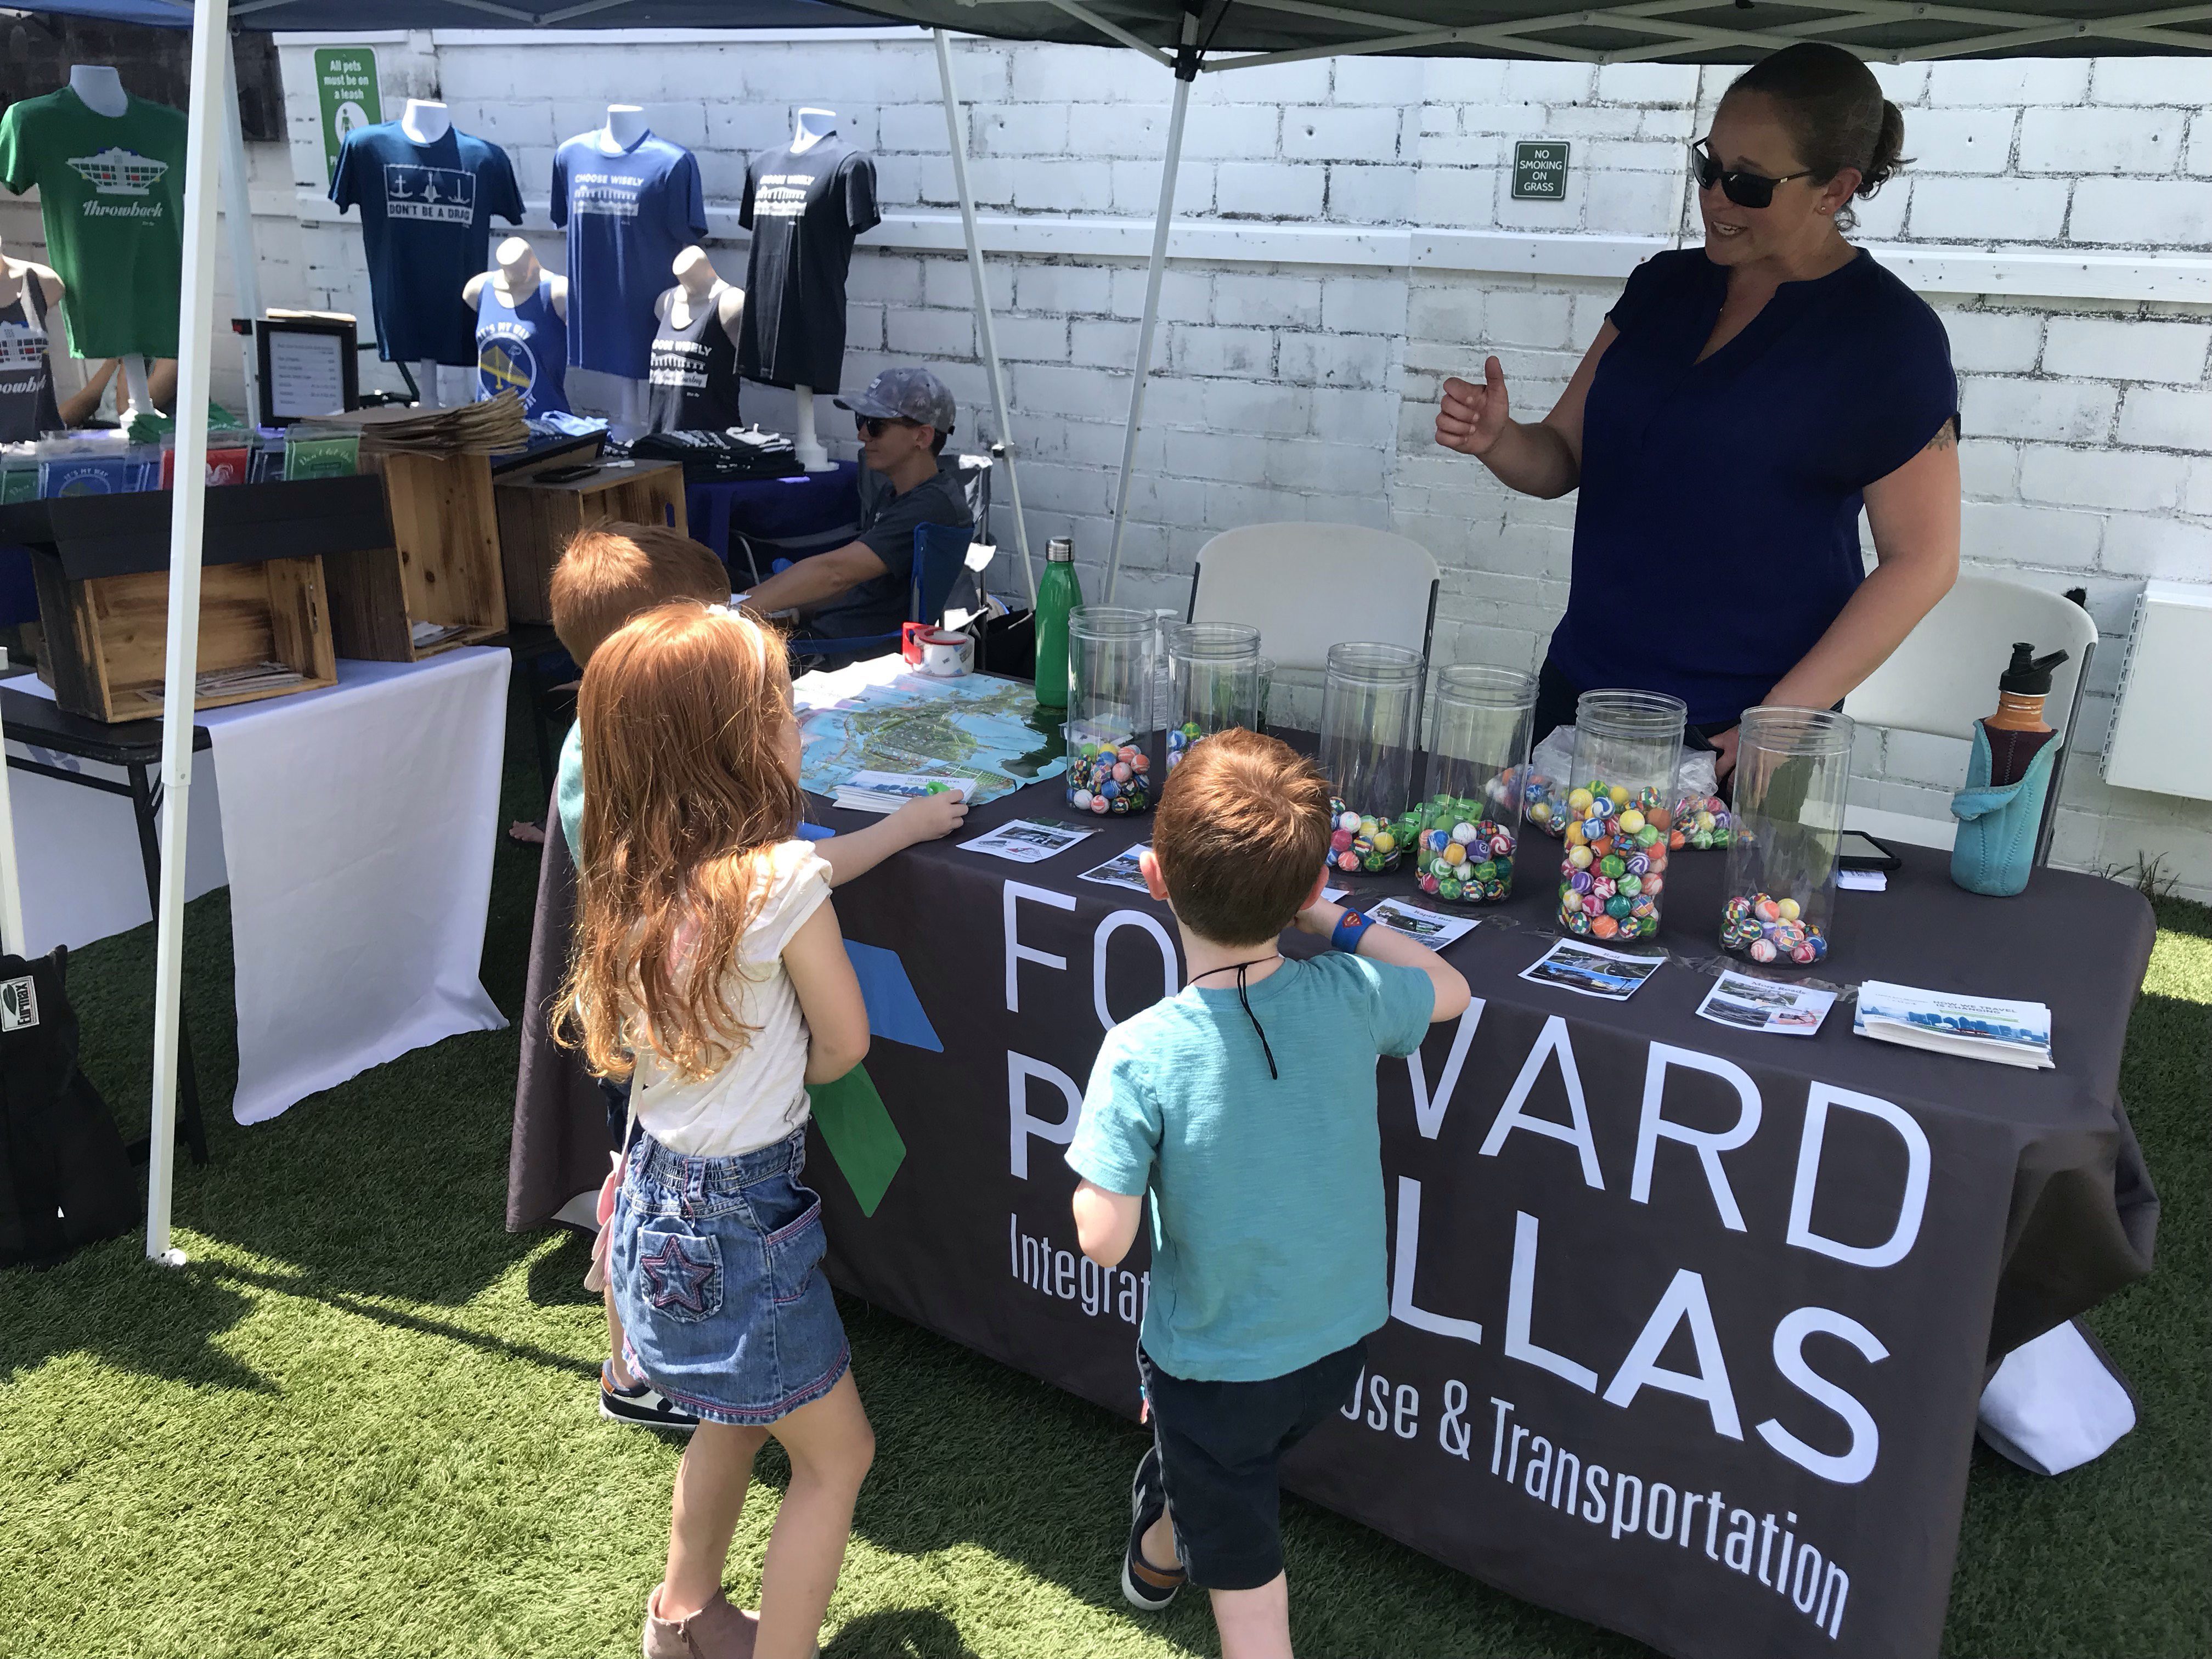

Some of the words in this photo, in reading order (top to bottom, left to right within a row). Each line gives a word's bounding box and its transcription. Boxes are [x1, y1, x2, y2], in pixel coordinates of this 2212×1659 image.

[330, 60, 341, 71] All
[343, 60, 362, 74] pets
[324, 74, 345, 86] must
[346, 74, 357, 85] be
[358, 76, 369, 86] on
[334, 90, 340, 99] a
[341, 88, 364, 99] leash
[1534, 150, 1550, 159] NO
[1520, 160, 1562, 170] SMOKING
[574, 173, 608, 184] CHOOSE
[611, 176, 644, 187] WISELY
[1532, 171, 1547, 180] ON
[1524, 182, 1554, 191] GRASS
[82, 200, 163, 217] Throwback
[390, 204, 417, 215] DON'T
[422, 205, 433, 217] BE
[438, 208, 444, 217] A
[498, 322, 512, 332] MY
[1413, 910, 1437, 918] Rapid
[1778, 986, 1806, 995] Roads
[1948, 1005, 2001, 1014] CHANGING
[1011, 1212, 1151, 1325] Integrat
[1439, 1379, 1471, 1462] &
[1490, 1396, 1850, 1640] Transportation
